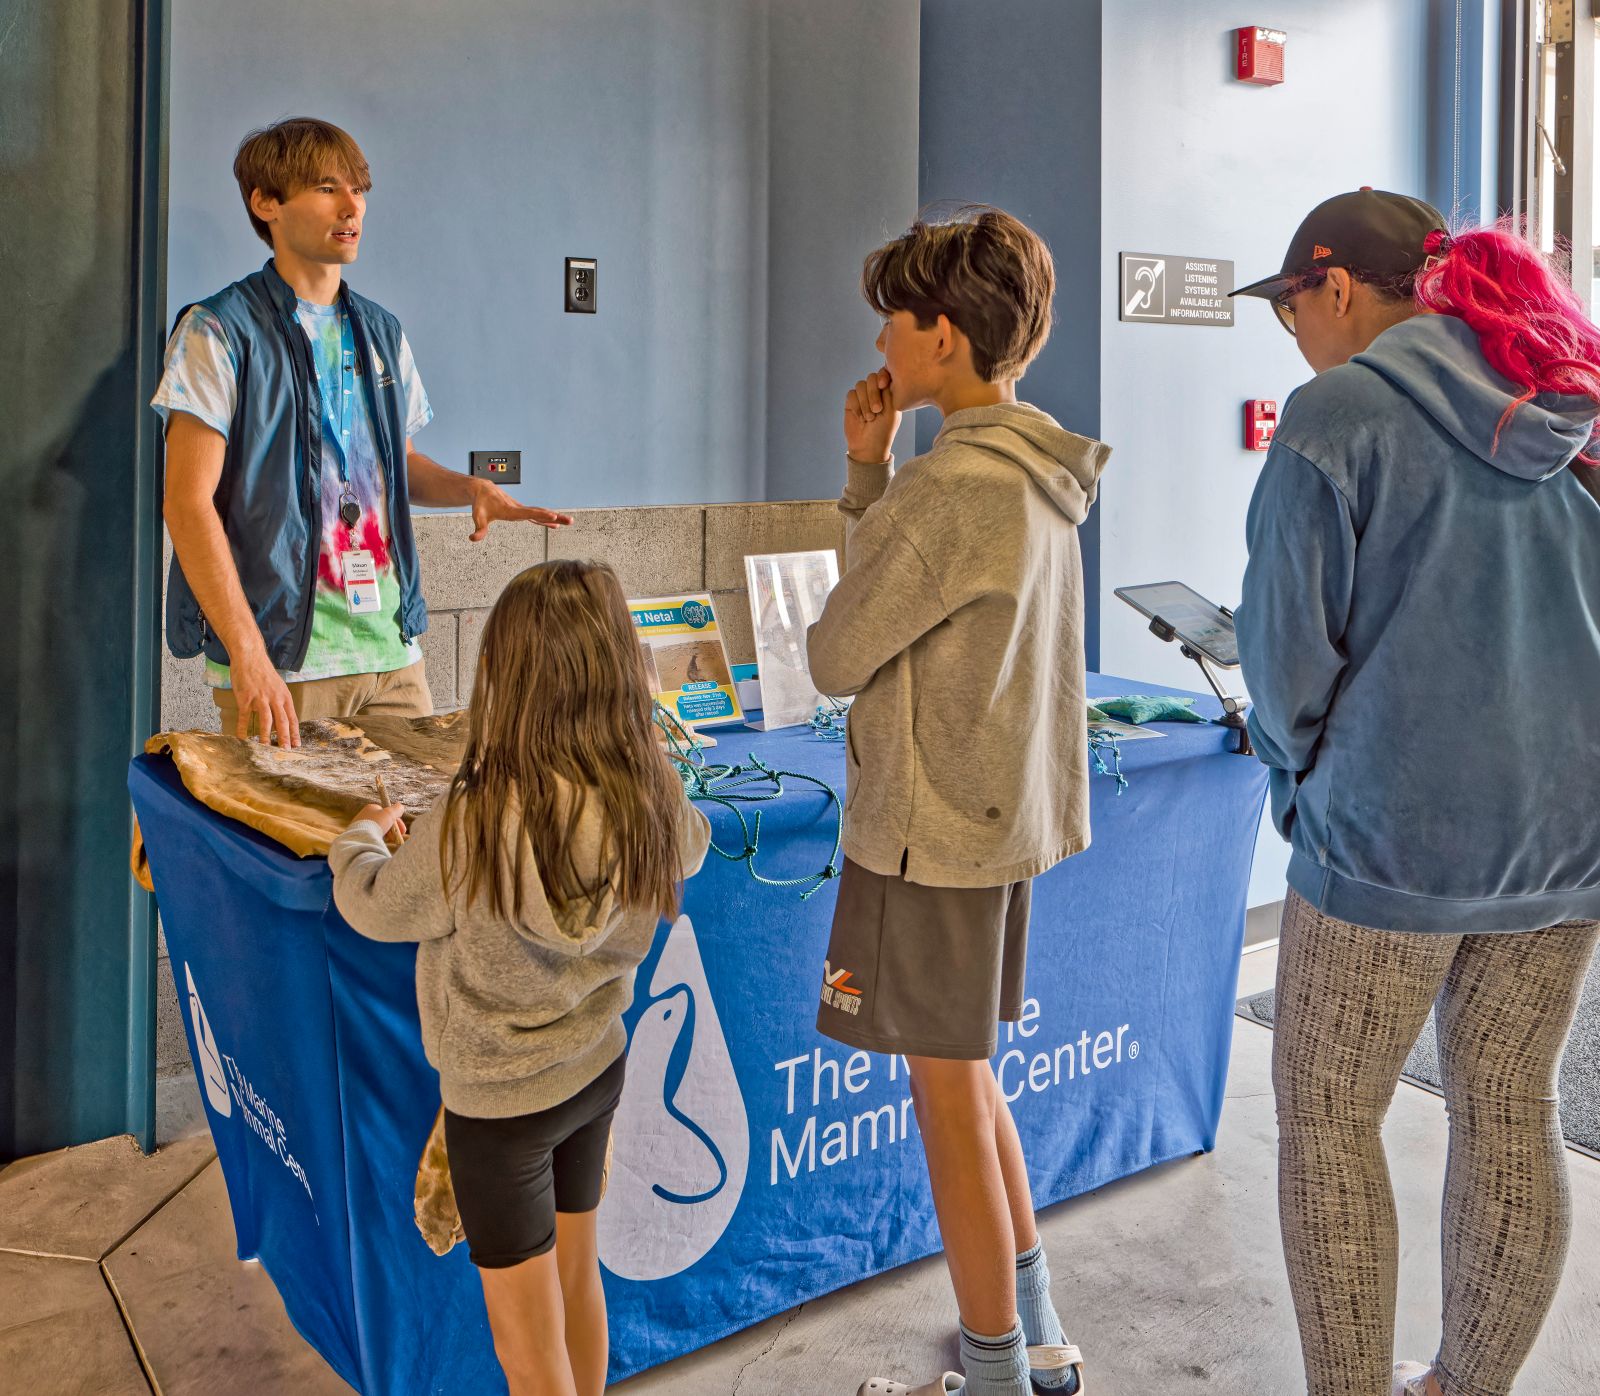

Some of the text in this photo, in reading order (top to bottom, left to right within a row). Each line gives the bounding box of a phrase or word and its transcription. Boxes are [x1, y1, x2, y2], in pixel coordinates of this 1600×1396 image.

[1185, 262, 1217, 272] ASSISTIVE
[1185, 274, 1217, 284] LISTENING
[1185, 286, 1217, 296] SYSTEM IS
[1180, 298, 1222, 307] AVAILABLE AT
[1170, 309, 1231, 320] INFORMATION DESK
[632, 614, 643, 625] et
[644, 611, 675, 624] Neta!
[832, 990, 862, 1016] SPORTS
[774, 1048, 871, 1115] The
[243, 1075, 287, 1142] Marine
